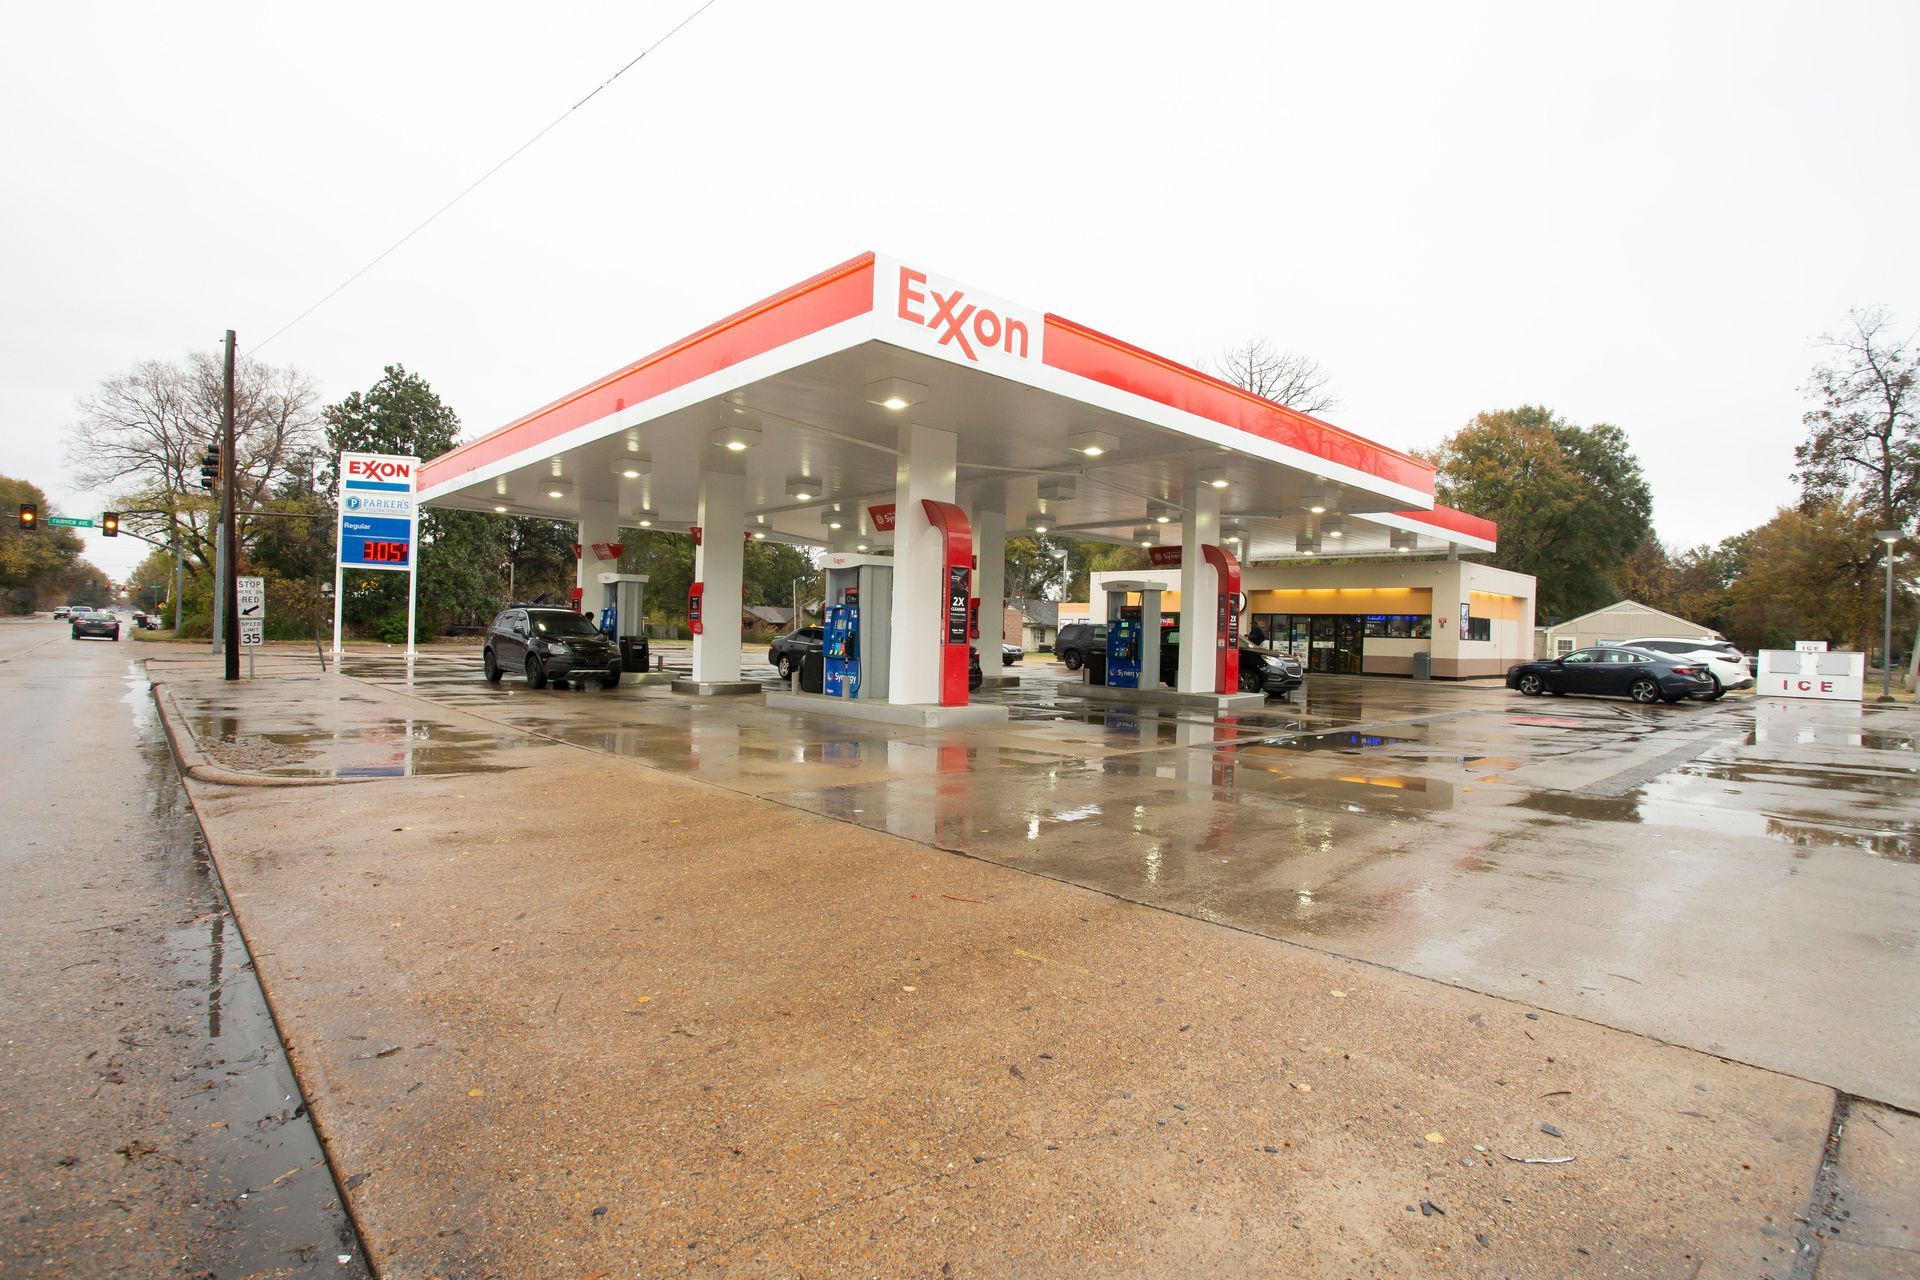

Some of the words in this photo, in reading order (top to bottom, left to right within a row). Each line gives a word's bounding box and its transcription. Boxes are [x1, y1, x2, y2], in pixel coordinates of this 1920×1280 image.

[898, 265, 1028, 362] Exxon
[349, 460, 409, 482] EXXON
[363, 499, 409, 509] PARKER'S
[344, 521, 371, 530] Regular
[238, 580, 261, 588] STOP
[241, 596, 260, 604] RED
[952, 596, 965, 607] 2X
[242, 633, 261, 644] 35
[1783, 680, 1833, 692] ICE
